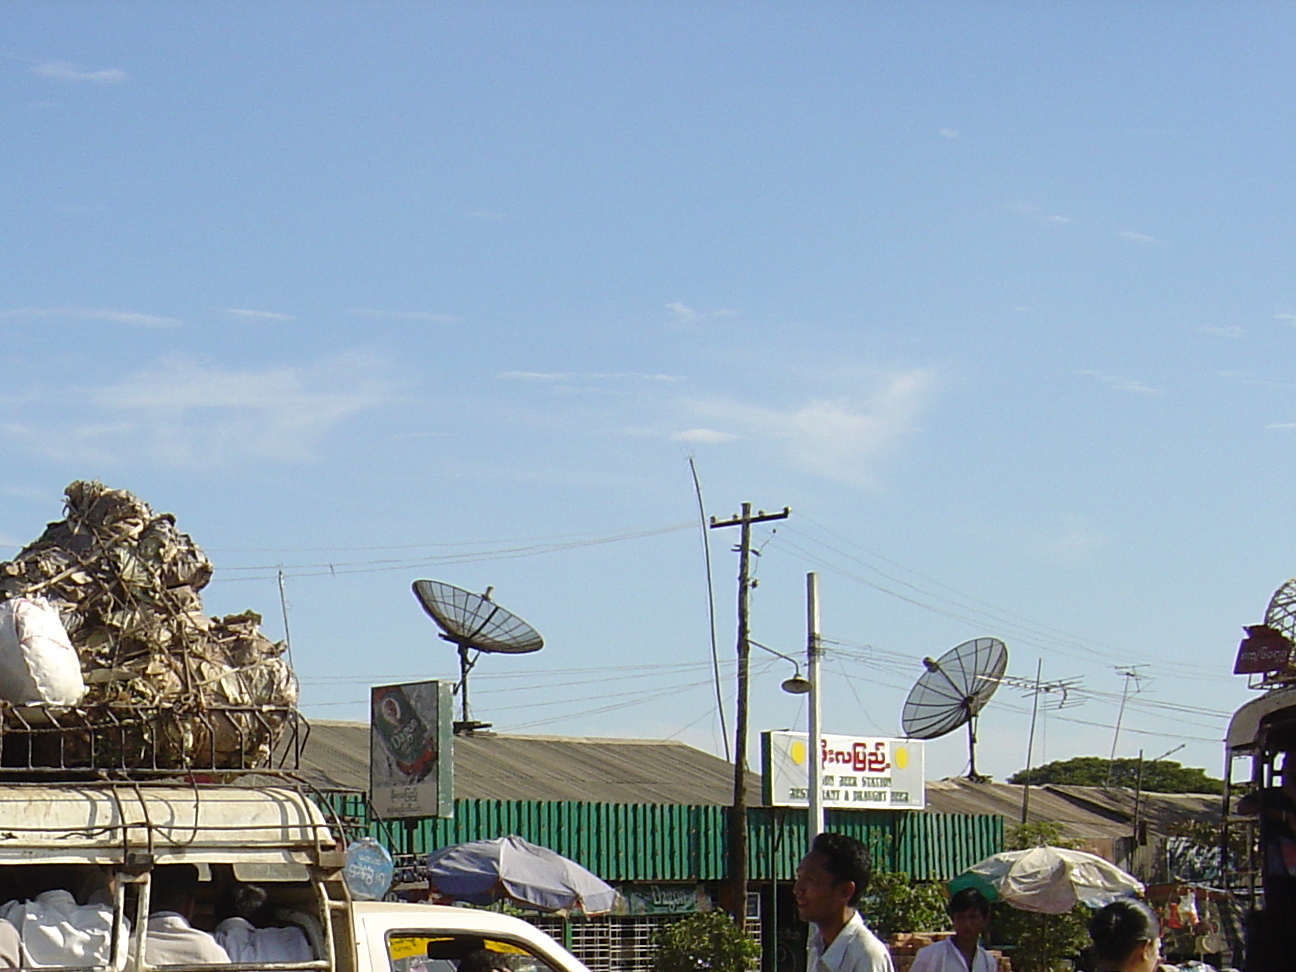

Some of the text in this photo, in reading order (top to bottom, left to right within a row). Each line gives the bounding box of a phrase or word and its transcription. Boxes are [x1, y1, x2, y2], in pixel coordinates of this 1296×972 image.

[839, 776, 857, 787] BEER
[862, 776, 892, 788] STATION
[853, 790, 887, 802] DRAUGHT
[891, 791, 909, 803] BEER
